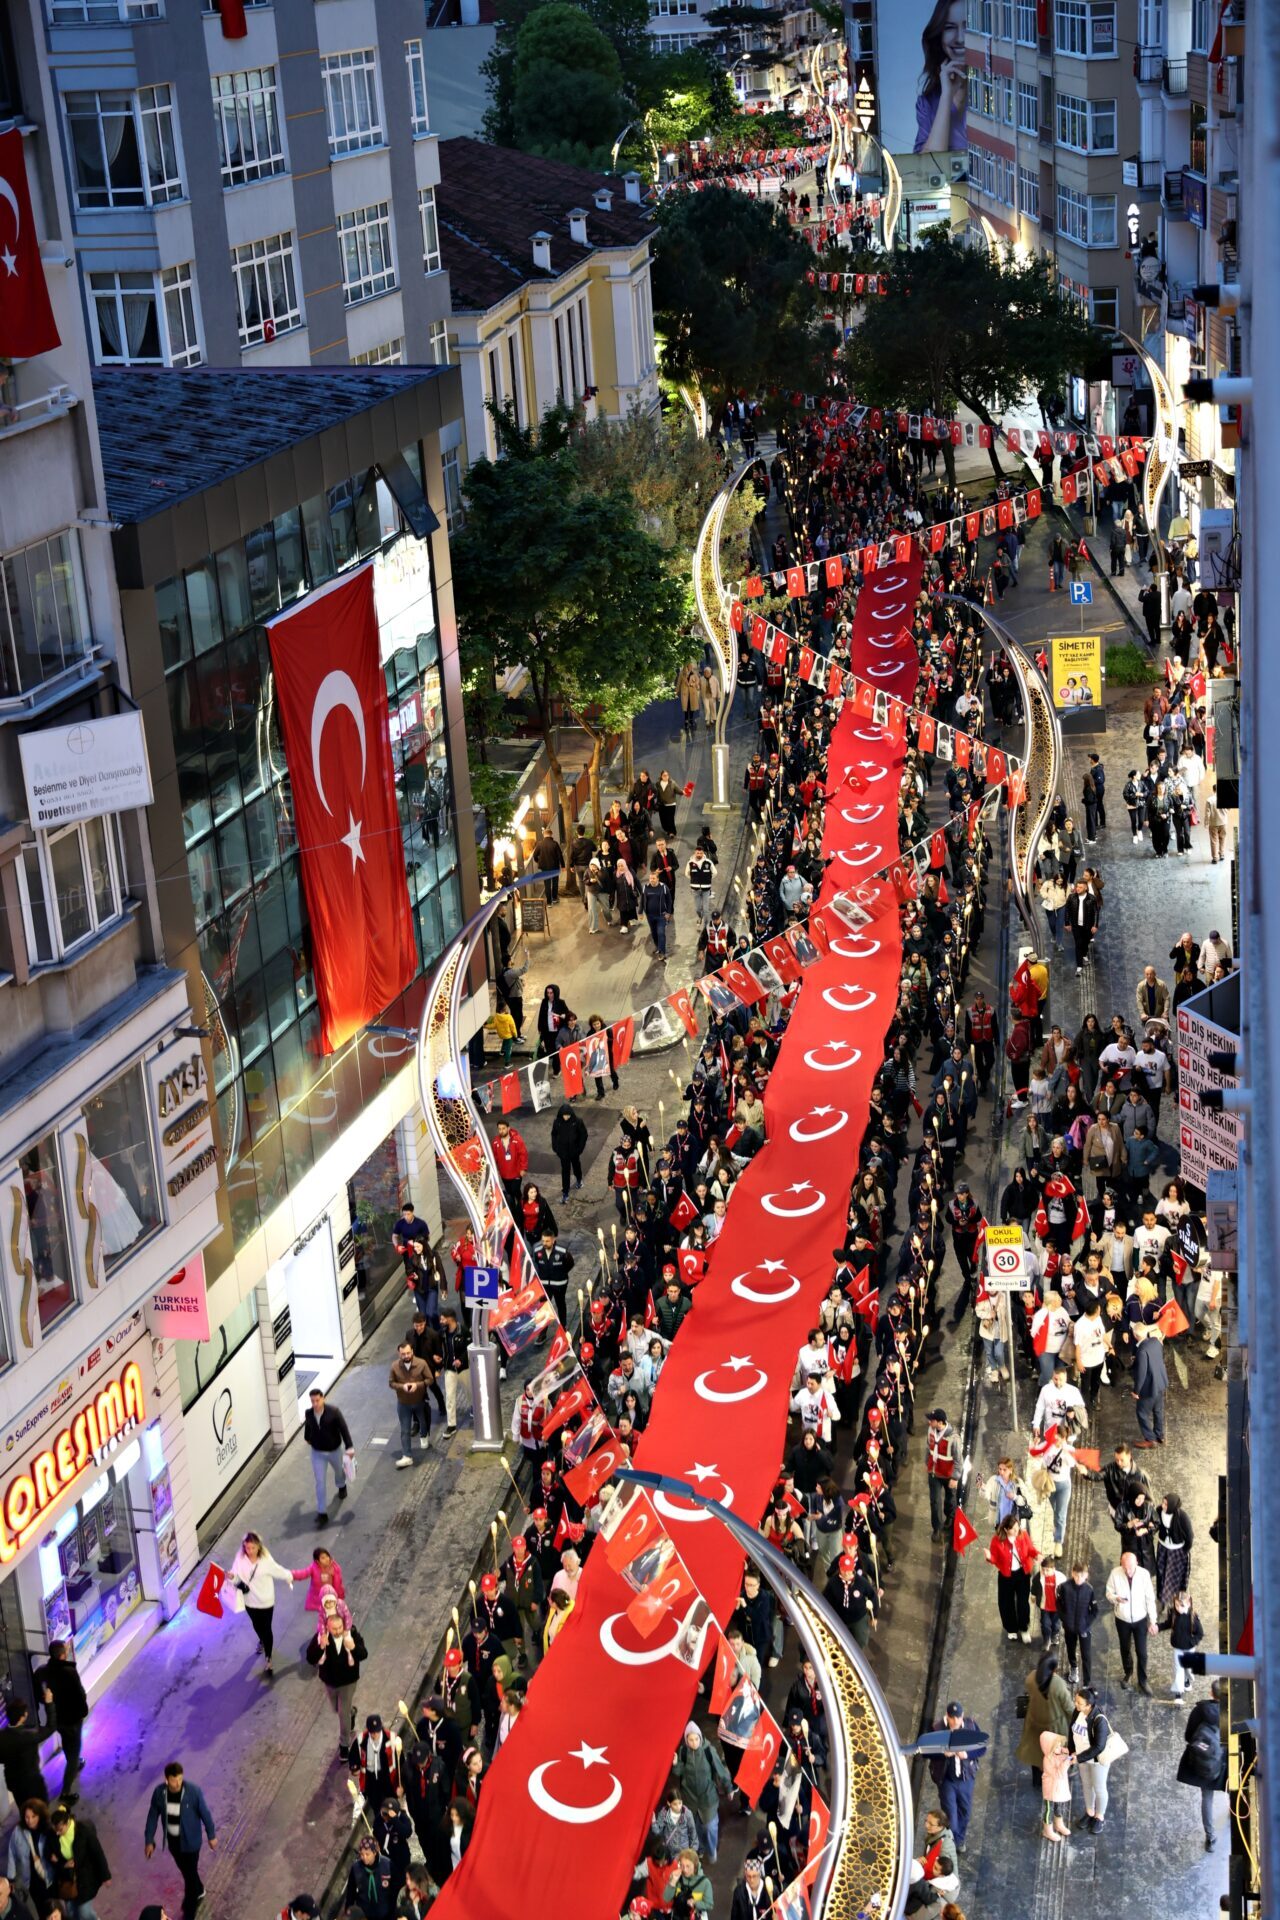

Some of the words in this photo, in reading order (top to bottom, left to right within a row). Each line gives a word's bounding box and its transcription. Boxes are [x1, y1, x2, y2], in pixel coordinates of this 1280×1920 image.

[1059, 640, 1095, 651] SİMETRİ
[33, 780, 68, 796] Beslenme
[69, 779, 78, 788] ve
[79, 773, 98, 787] Diyet
[38, 801, 88, 821] Diyetisyen
[1179, 1031, 1203, 1055] MURAT
[1191, 1020, 1205, 1042] DİŞ
[1206, 1029, 1236, 1054] HEKİMİ
[1192, 1059, 1206, 1080] DİŞ
[160, 1055, 208, 1117] AYSA
[1180, 1070, 1213, 1095] BÜNYAMİ
[1208, 1108, 1237, 1136] HEKİMİ
[1194, 1138, 1207, 1158] DİŞ
[988, 1236, 1022, 1245] BÖLGESİ
[998, 1255, 1015, 1267] 30
[474, 1269, 490, 1296] P
[153, 1294, 199, 1304] TURKISH
[153, 1303, 200, 1313] AIRLINES
[15, 1404, 49, 1443] SunExpress
